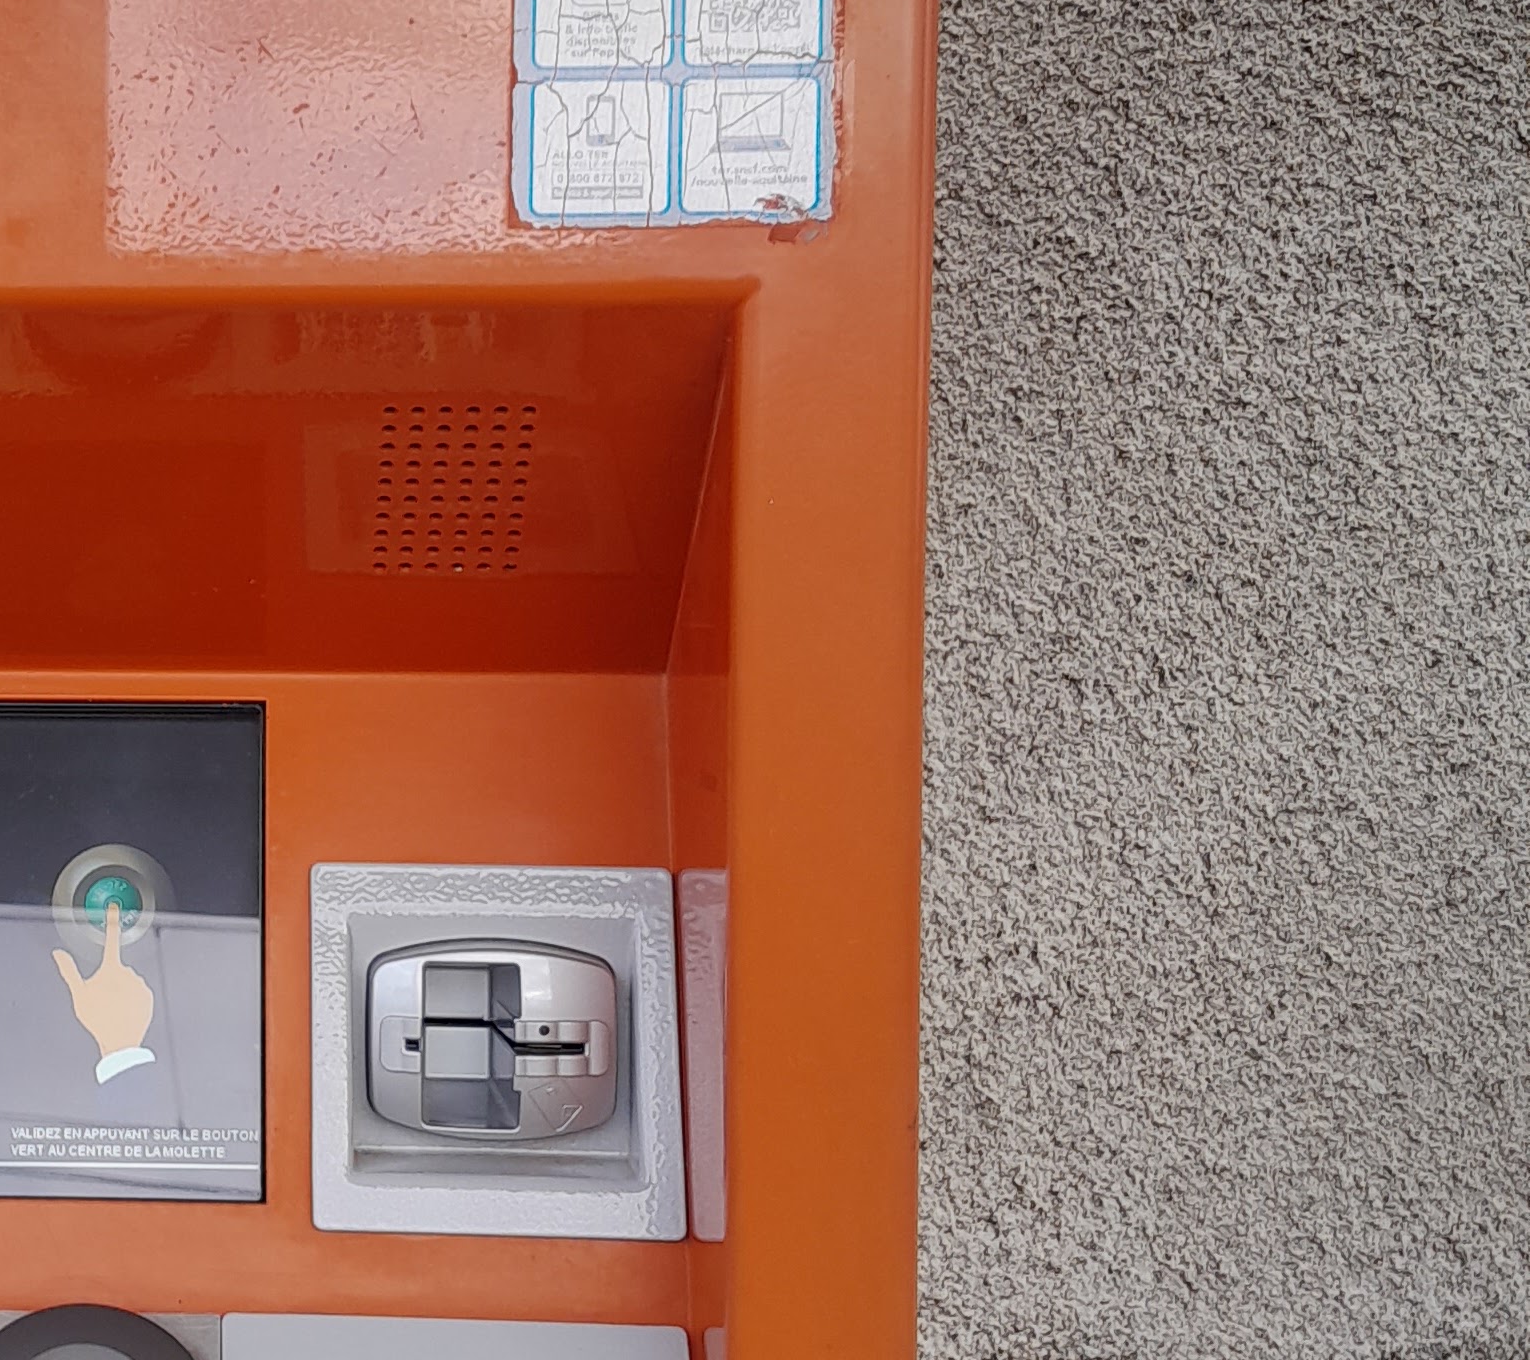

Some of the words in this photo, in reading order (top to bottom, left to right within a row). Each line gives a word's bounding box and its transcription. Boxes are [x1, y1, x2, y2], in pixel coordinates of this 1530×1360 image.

[11, 1127, 61, 1139] VALIDEZ
[64, 1128, 82, 1140] EN
[83, 1128, 149, 1140] APPUYANT
[153, 1129, 181, 1141] SUR
[183, 1129, 199, 1141] LE
[202, 1129, 259, 1142] BOUTON
[11, 1144, 44, 1156] VERT
[48, 1144, 66, 1156] AU
[69, 1144, 121, 1157] CENTRE
[124, 1145, 142, 1158] DE
[145, 1146, 162, 1158] LA
[162, 1146, 224, 1158] MOLETTE
